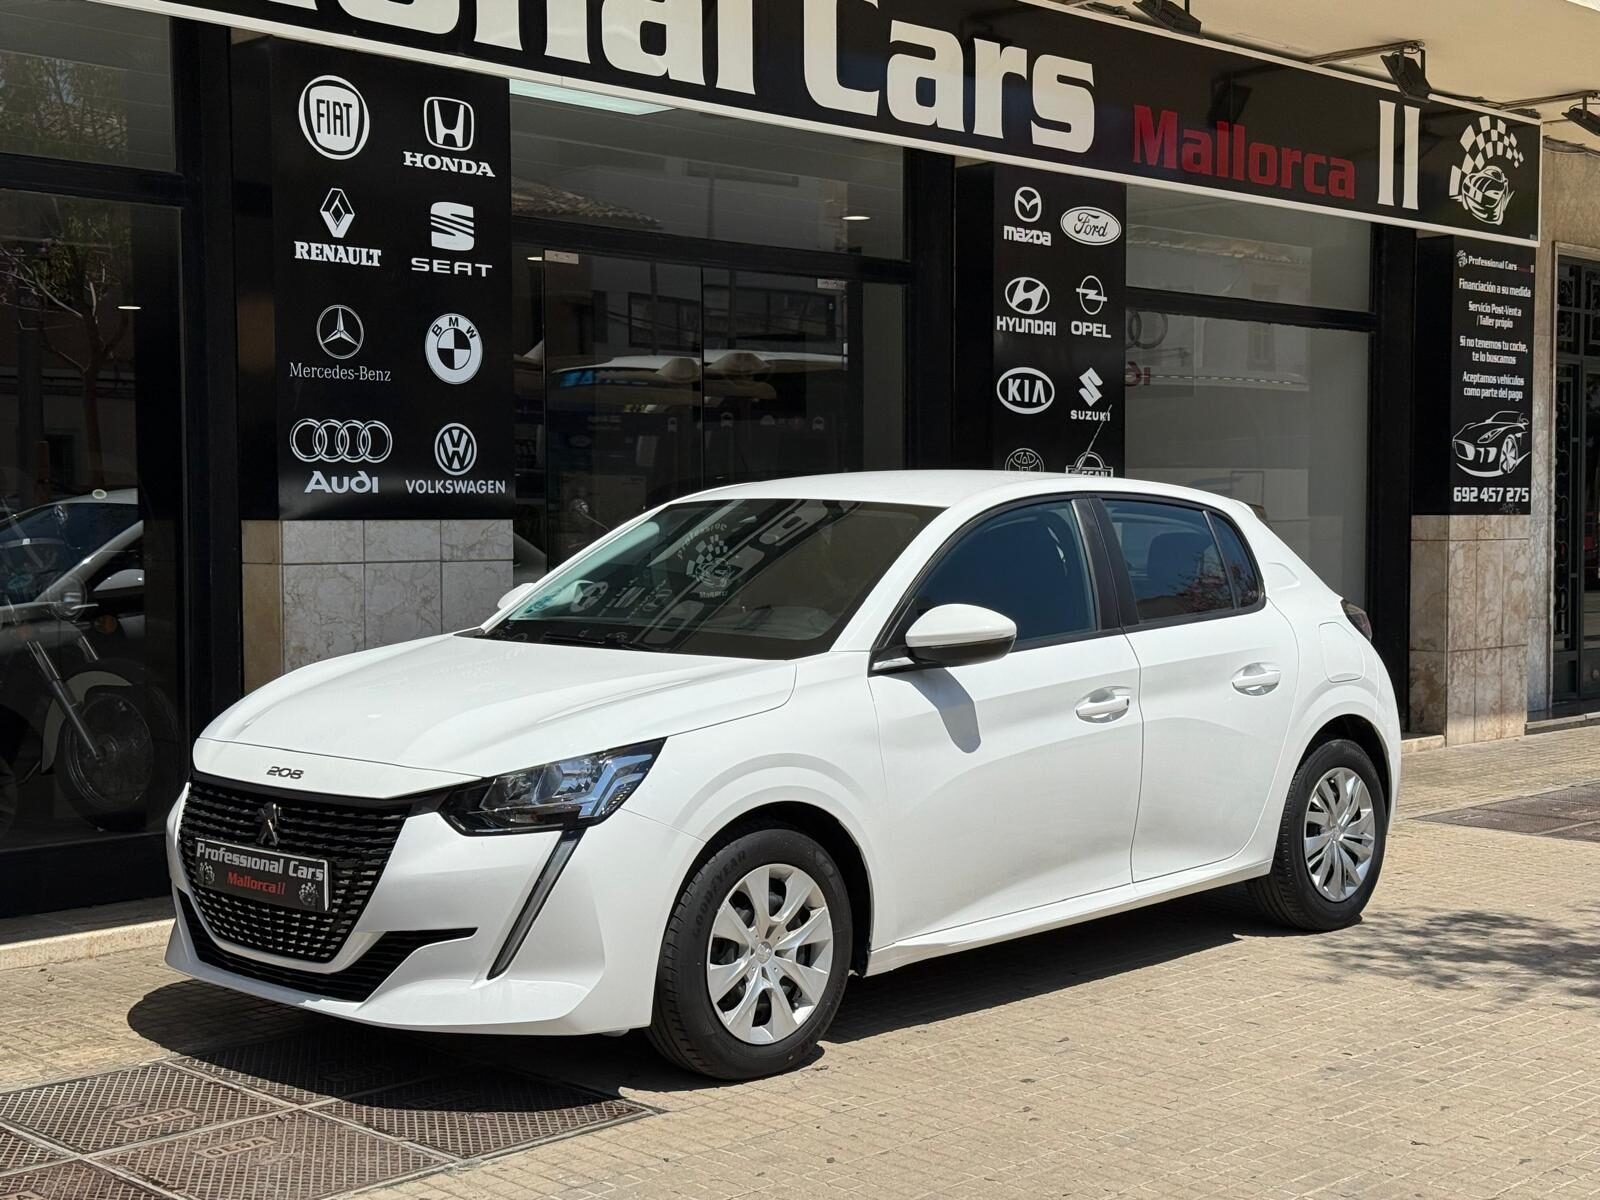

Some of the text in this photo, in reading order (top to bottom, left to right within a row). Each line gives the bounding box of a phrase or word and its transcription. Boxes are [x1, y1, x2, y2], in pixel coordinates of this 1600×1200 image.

[803, 0, 1097, 154] Cars
[1133, 104, 1357, 200] Mallorca
[317, 98, 353, 138] FIAT
[403, 151, 496, 178] HONDA
[1074, 212, 1109, 238] Ford
[294, 240, 382, 267] RENAULT
[1468, 255, 1505, 269] Professional
[1504, 260, 1518, 271] Cars
[411, 257, 493, 277] SEAT
[1459, 278, 1532, 298] Financiación a su medida
[1468, 300, 1522, 317] Servicio Post-Venta
[431, 316, 479, 341] BMW
[997, 315, 1057, 337] HYUNDAI
[1071, 320, 1112, 339] OPEL
[1479, 315, 1495, 326] Taller
[1459, 335, 1529, 354] Si no tenemos tu coche,
[1472, 351, 1517, 365] te lo buscamos
[289, 362, 392, 382] Mercedes-Benz
[1462, 371, 1497, 385] Aceptamos
[1007, 377, 1046, 404] KIA
[1463, 387, 1524, 402] como parte del pago
[1070, 409, 1112, 422] SUZUKI
[304, 470, 379, 494] Audi
[405, 480, 506, 494] VOLKSWAGEN
[1453, 486, 1530, 503] 692 457 275
[266, 766, 304, 780] 208
[196, 842, 325, 882] Professional Cars
